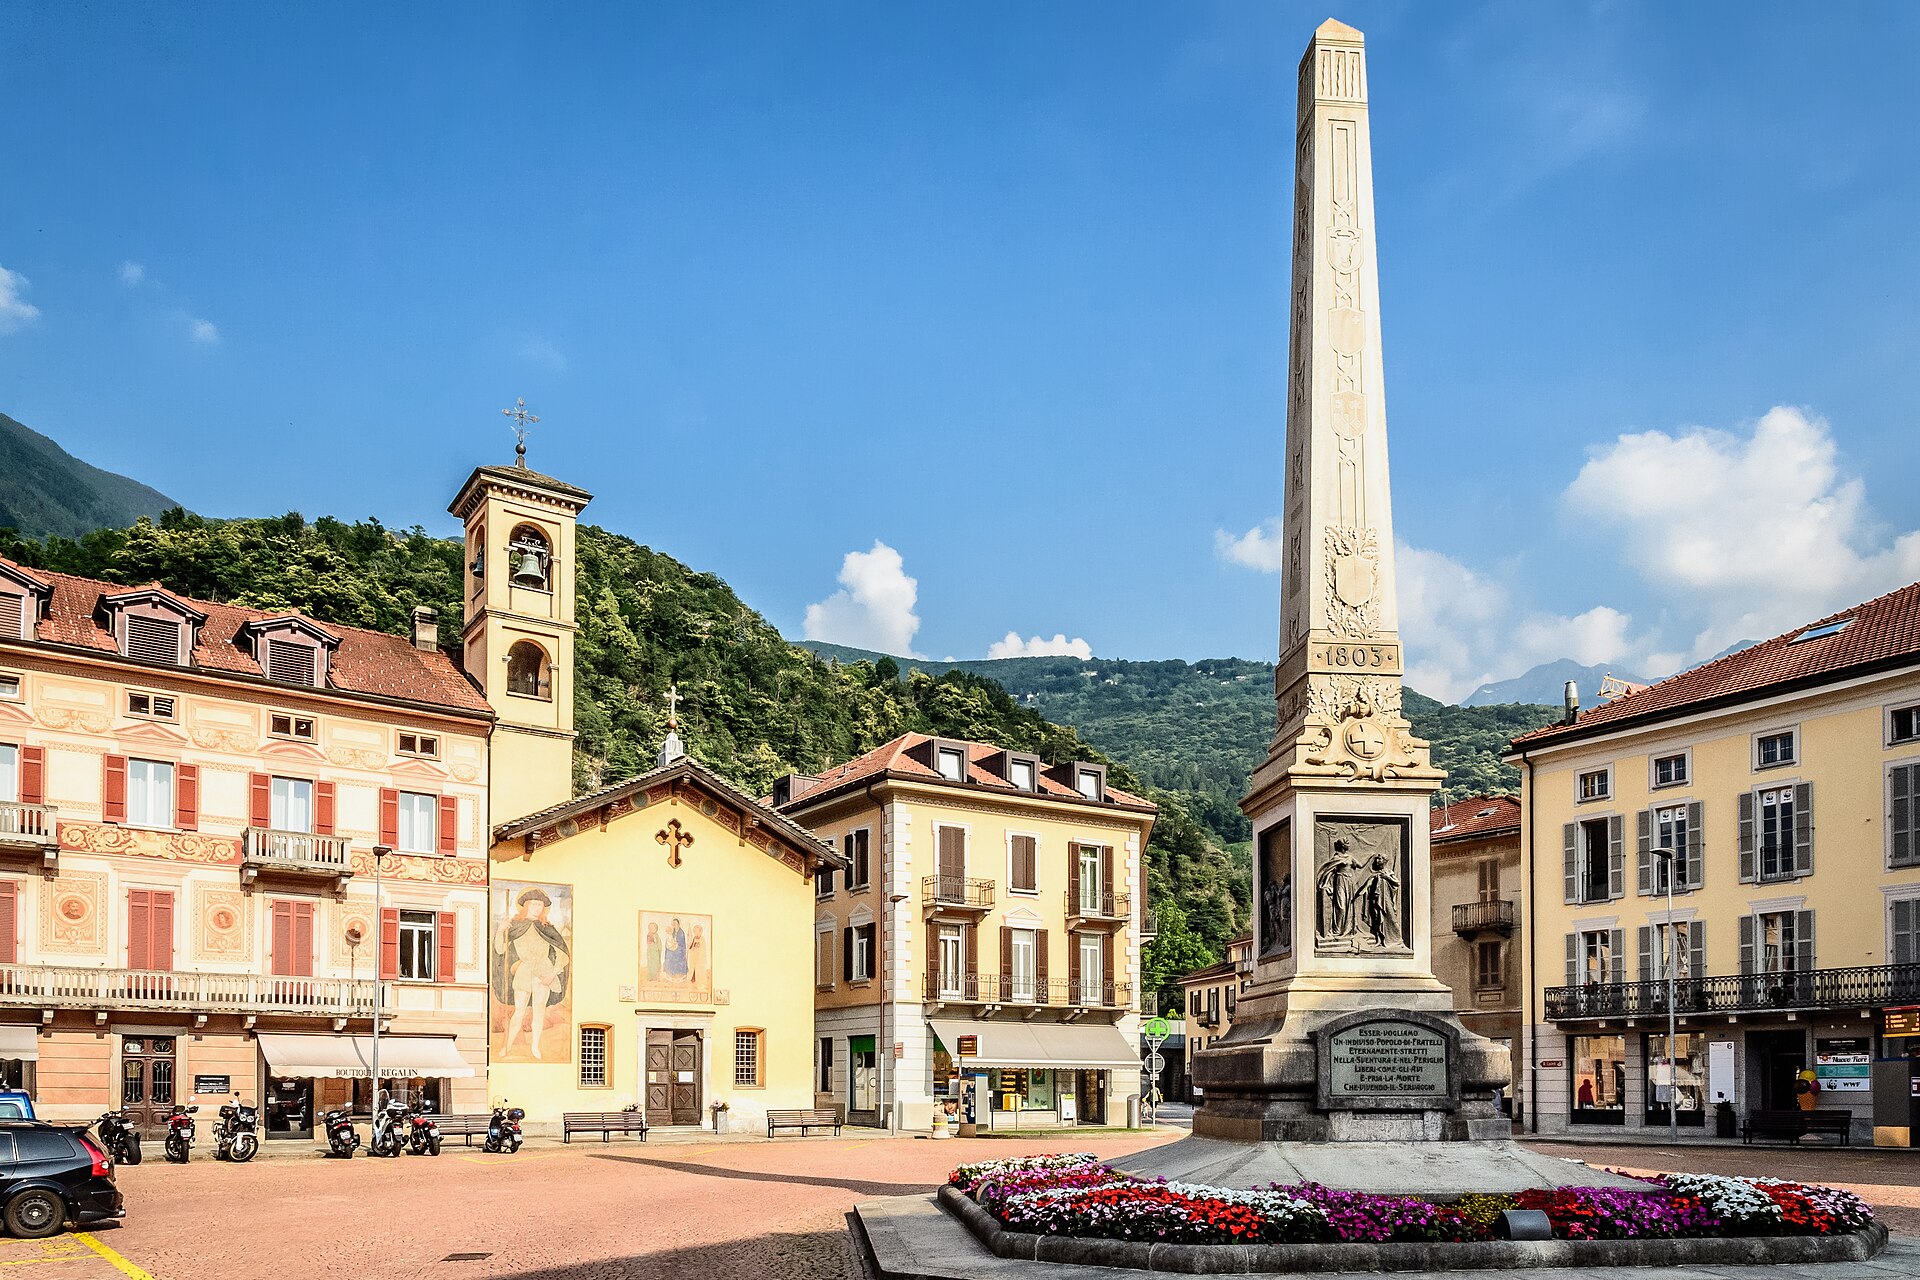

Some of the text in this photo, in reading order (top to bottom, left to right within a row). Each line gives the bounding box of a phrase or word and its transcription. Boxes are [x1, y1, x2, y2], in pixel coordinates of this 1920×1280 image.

[1326, 646, 1383, 667] 1803
[1359, 1029, 1381, 1037] ESSER
[1376, 1038, 1402, 1046] POPOLO
[1413, 1038, 1443, 1046] FRATELLI
[1349, 1047, 1398, 1055] ETERNAMENTE
[1334, 1056, 1355, 1064] NELLA
[1413, 1056, 1444, 1064] PERIGLIO
[336, 1068, 418, 1077] BOUTIQU REGALIN
[1396, 1074, 1421, 1082] MORTE
